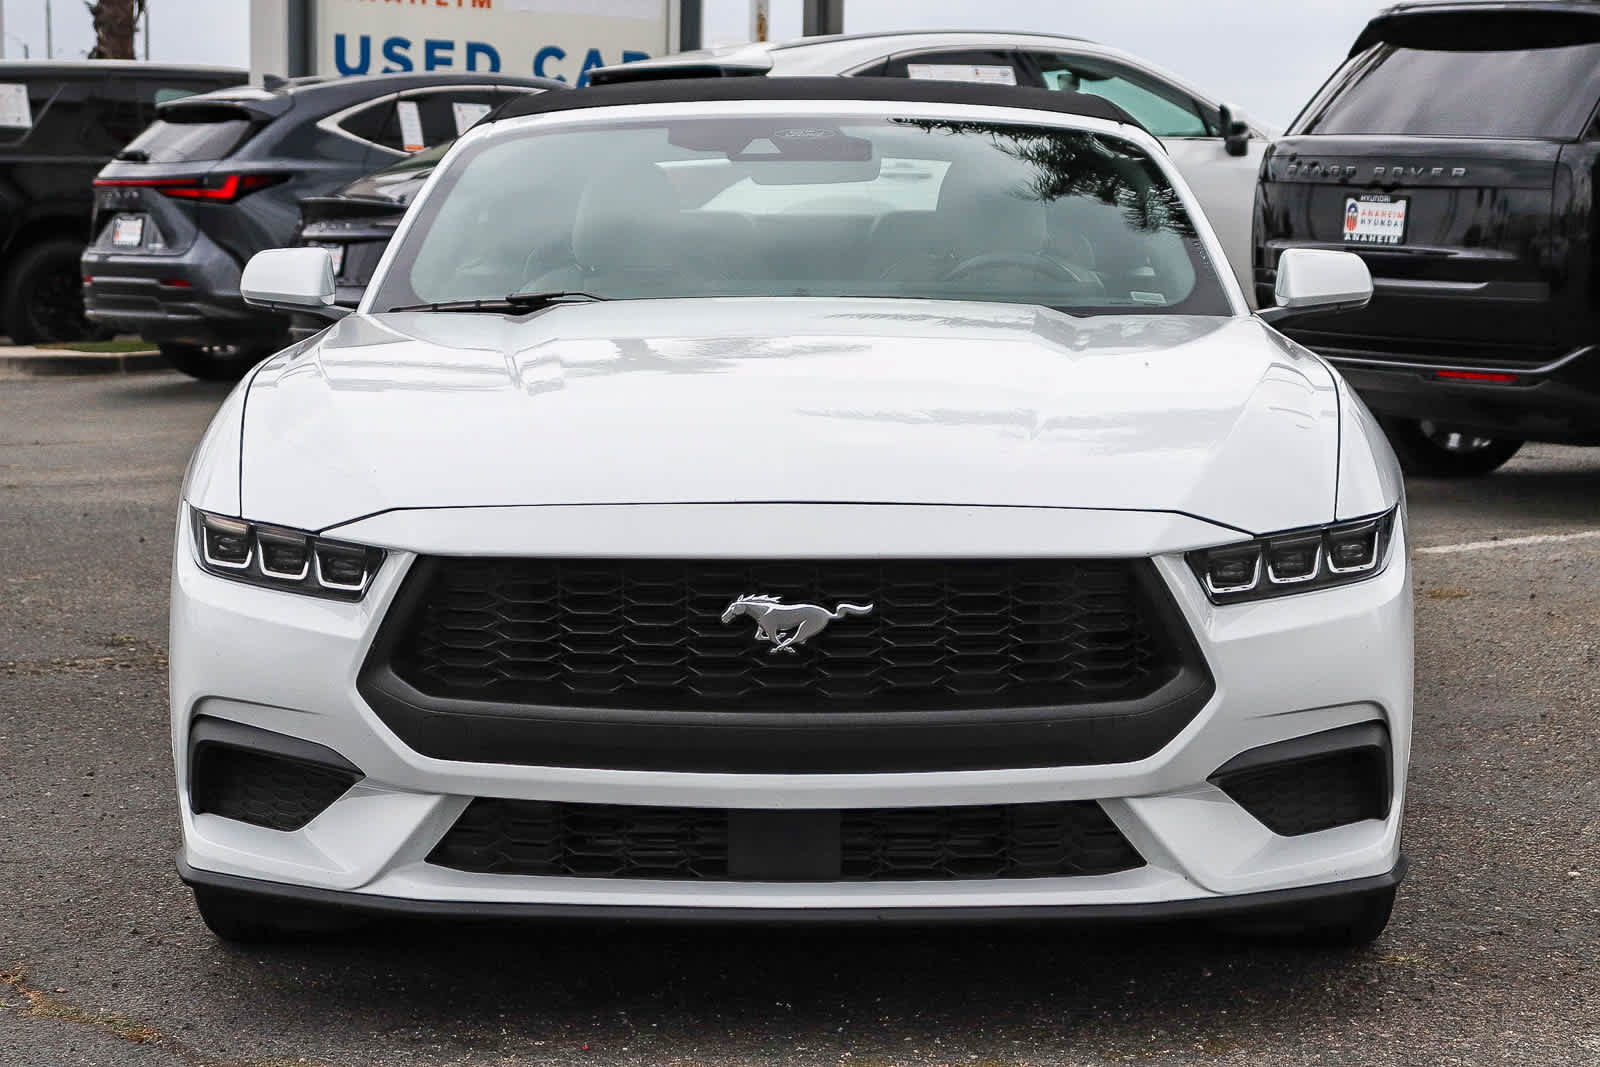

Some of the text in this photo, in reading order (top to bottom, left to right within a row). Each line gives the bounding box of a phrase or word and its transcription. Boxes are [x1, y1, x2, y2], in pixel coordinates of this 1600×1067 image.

[334, 33, 652, 89] USED CA
[1373, 166, 1467, 178] ROVER
[1360, 218, 1404, 228] HYUNDAI
[1344, 232, 1399, 243] ANAHEIM
